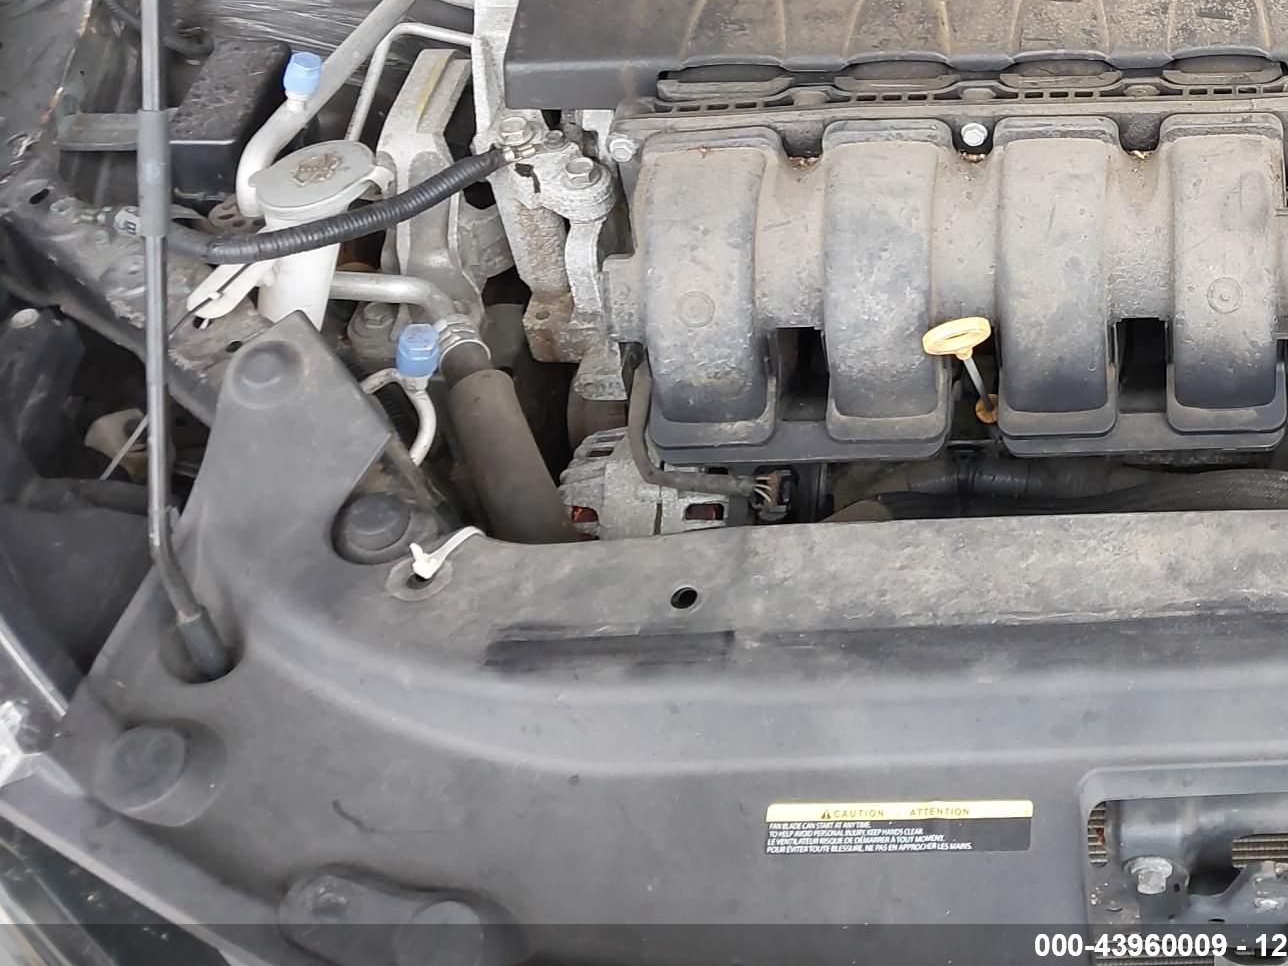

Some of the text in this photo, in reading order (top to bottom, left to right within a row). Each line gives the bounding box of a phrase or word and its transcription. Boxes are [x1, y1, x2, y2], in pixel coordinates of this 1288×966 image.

[833, 807, 970, 818] CAUTION ATTENTION
[769, 822, 782, 830] FAN
[767, 838, 776, 846] LE
[776, 837, 819, 845] VENTILATEUR
[819, 837, 844, 845] RISQUE
[854, 836, 890, 844] DÉMARRER
[896, 836, 914, 844] TOUT
[786, 844, 808, 853] ÉVITER
[809, 845, 830, 853] TOUTE
[865, 844, 874, 852] NE
[898, 842, 936, 851] APPROCHER
[937, 842, 949, 850] LES
